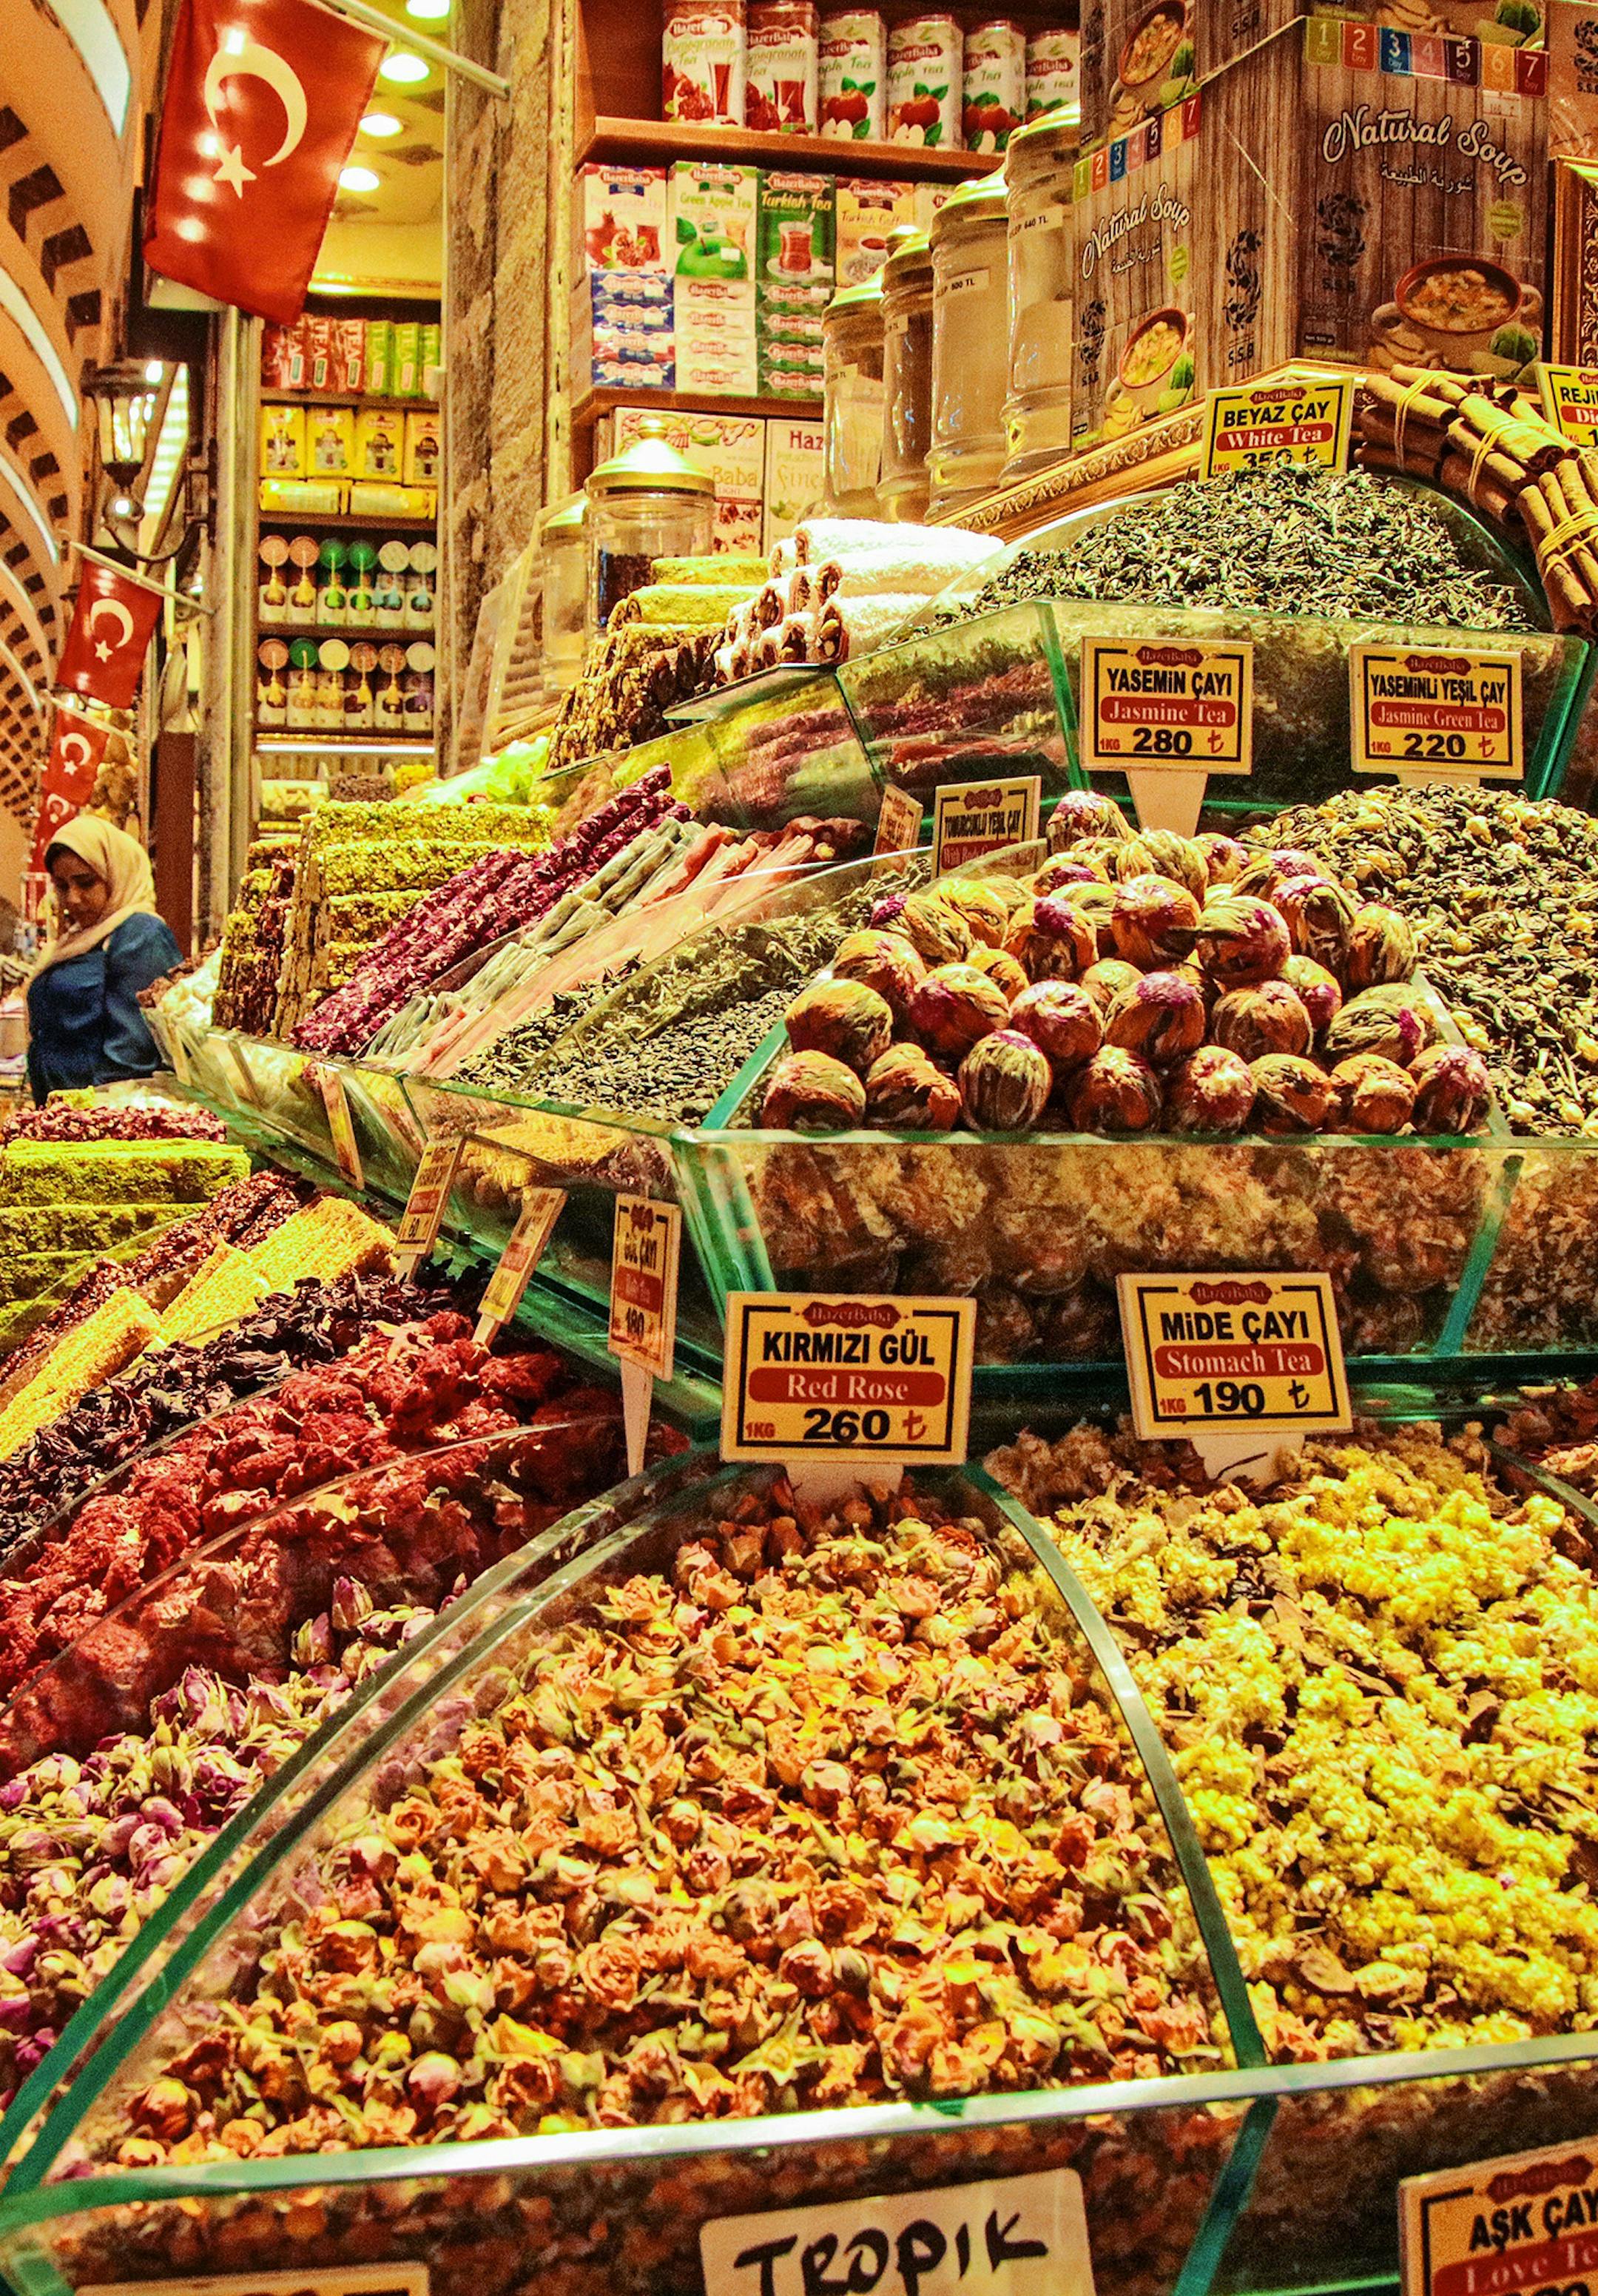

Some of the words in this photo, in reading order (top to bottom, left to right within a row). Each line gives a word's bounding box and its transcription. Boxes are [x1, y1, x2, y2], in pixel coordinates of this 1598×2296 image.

[1320, 24, 1329, 45] 1
[1352, 29, 1366, 51] 2
[1389, 34, 1400, 57] 3
[679, 53, 698, 65] Tea
[1422, 41, 1434, 61] 4
[1456, 46, 1471, 68] 5
[1491, 51, 1504, 72] 6
[852, 57, 872, 69] Tea
[1525, 55, 1540, 77] 7
[981, 70, 1001, 81] Tea
[1187, 99, 1196, 124] 7
[1150, 122, 1159, 145] 5
[1113, 145, 1123, 165] 3
[1322, 105, 1451, 163] Natural
[1457, 121, 1527, 186] Soup
[1095, 154, 1104, 175] 2
[680, 192, 705, 204] Green
[709, 195, 735, 209] Apple
[738, 197, 752, 209] Tea
[761, 191, 806, 209] Turkish
[811, 194, 832, 211] Tea
[840, 210, 876, 223] Turkish
[878, 211, 901, 224] Coff
[1039, 215, 1048, 224] TL
[1082, 191, 1147, 279] Natural
[1150, 183, 1190, 232] Soup
[965, 278, 975, 286] TL
[371, 324, 386, 360] TEA
[400, 327, 416, 363] TEA
[423, 329, 437, 363] TEA
[1223, 405, 1287, 428] BEYAZ
[1290, 401, 1331, 425] ÇAY
[789, 430, 825, 451] Haz
[1227, 430, 1284, 449] White
[1289, 425, 1323, 444] Tea
[1242, 448, 1294, 469] 350
[712, 465, 758, 487] Baba
[1140, 649, 1198, 664] HazerBaba
[1191, 671, 1232, 701] ÇAYI
[1480, 680, 1506, 708] ÇAY
[1109, 701, 1189, 722] Jasmine
[1193, 703, 1227, 724] Tea
[1378, 705, 1431, 725] Jasmine
[1433, 708, 1473, 729] Green
[1475, 711, 1498, 730] Tea
[1099, 738, 1121, 751] 1KG
[1133, 727, 1193, 755] 280
[1370, 741, 1392, 754] 1KG
[1403, 733, 1466, 758] 220
[811, 1305, 891, 1323] HazerBaba
[1241, 1311, 1310, 1345] ÇAYI
[762, 1331, 871, 1364] KIRMIZI
[879, 1328, 935, 1366] GÜL
[1166, 1350, 1267, 1374] Stomach
[1271, 1348, 1312, 1372] Tea
[786, 1373, 837, 1398] Red
[848, 1375, 909, 1401] Rose
[1159, 1398, 1187, 1414] 1KG
[1193, 1381, 1266, 1415] 190
[744, 1421, 775, 1438] 1KG
[803, 1407, 891, 1443] 260
[1469, 2201, 1534, 2257] AŞK
[1542, 2188, 1598, 2243] ÇAY
[1466, 2258, 1548, 2294] Love
